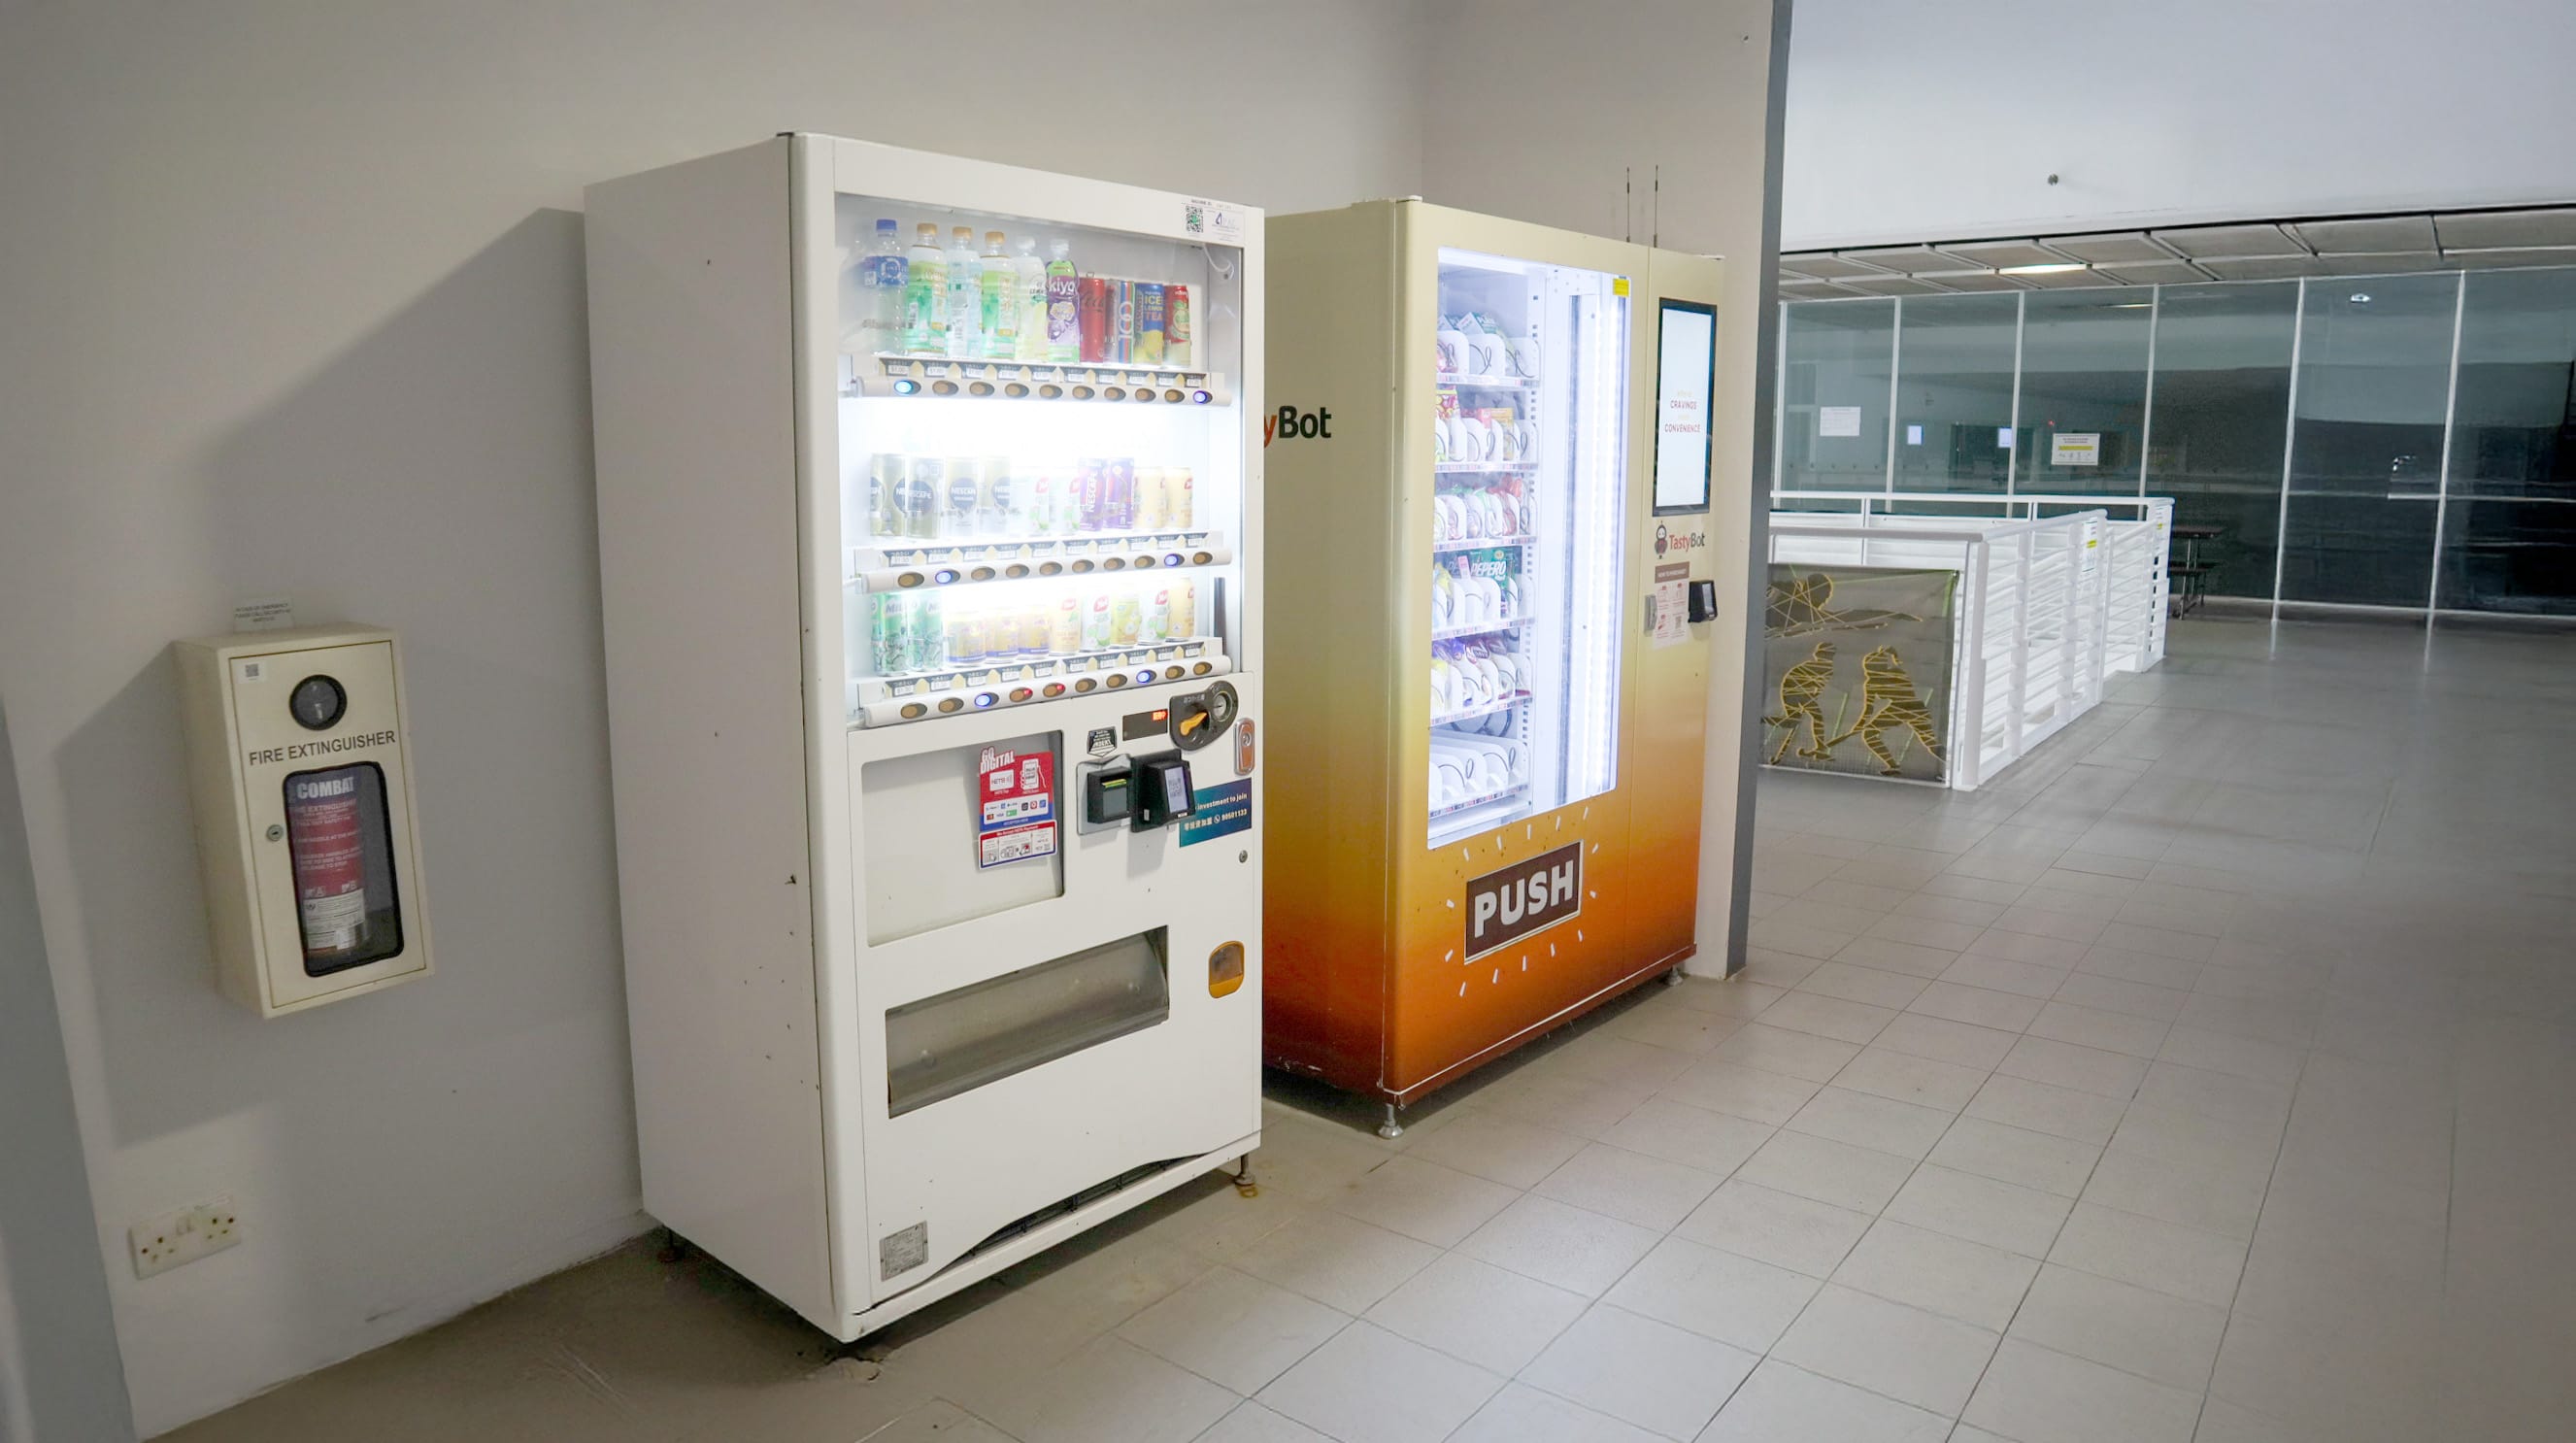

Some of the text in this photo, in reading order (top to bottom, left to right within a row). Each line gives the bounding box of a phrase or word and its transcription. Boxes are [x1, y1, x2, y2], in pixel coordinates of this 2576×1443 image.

[1144, 295, 1163, 305] ICE
[1145, 311, 1163, 322] TEA
[1669, 532, 1705, 552] TastyBot
[250, 730, 396, 765] FIRE EXTINGUISHER
[982, 748, 994, 761] GO
[981, 751, 1015, 774] DIGITAL
[297, 777, 354, 799] COMBAT
[1474, 859, 1573, 939] PUSH
